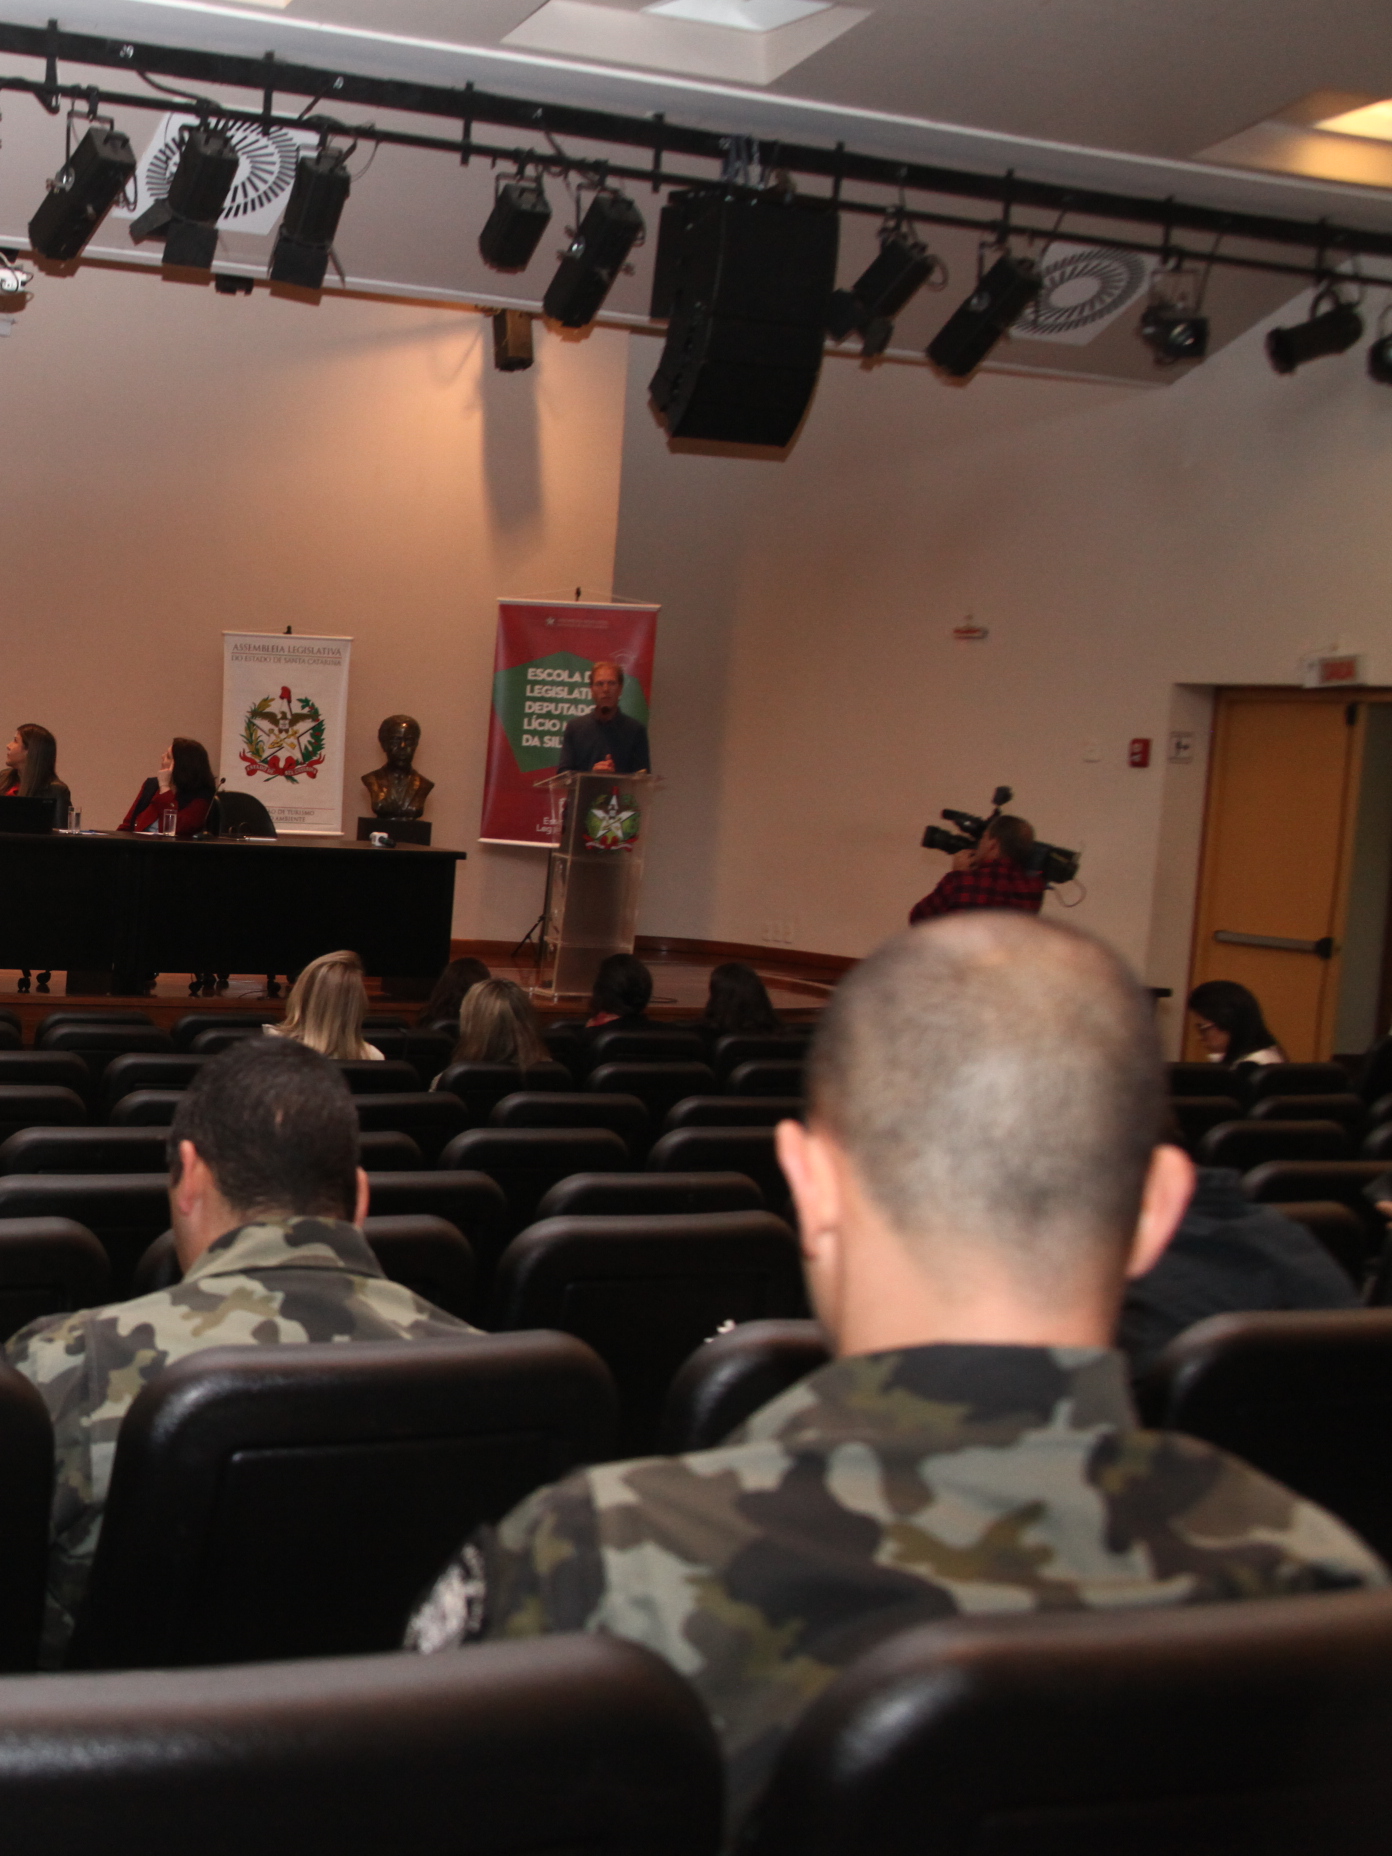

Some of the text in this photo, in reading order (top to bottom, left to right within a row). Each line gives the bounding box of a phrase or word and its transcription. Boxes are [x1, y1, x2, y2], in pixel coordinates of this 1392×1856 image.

[232, 643, 342, 657] ASSEMBLEIA LEGISLATIVA
[244, 655, 271, 663] ESTADO
[284, 657, 306, 665] SANTA
[307, 658, 342, 667] CATARINA
[527, 668, 582, 682] ESCOLA
[526, 685, 592, 700] LEGISLATI
[523, 715, 560, 731] LÍCIO
[522, 734, 564, 748] DA SIL
